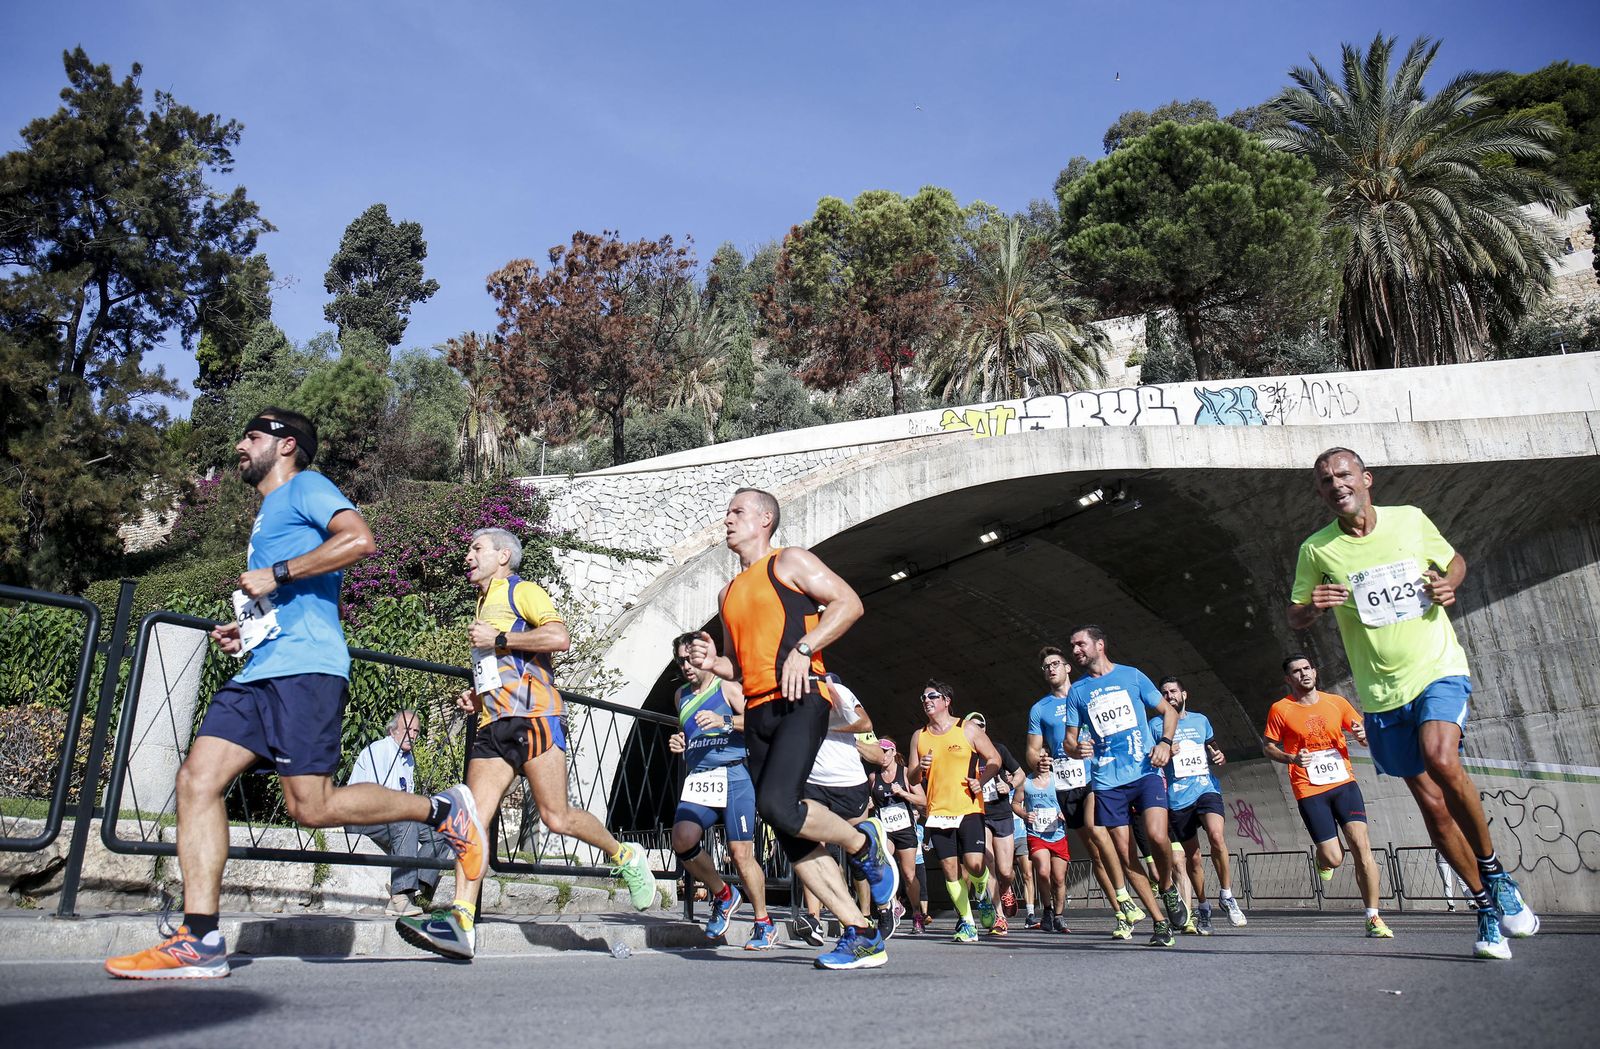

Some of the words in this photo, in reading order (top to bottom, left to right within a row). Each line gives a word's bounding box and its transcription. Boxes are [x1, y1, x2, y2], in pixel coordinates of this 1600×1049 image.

[1298, 377, 1361, 419] ACAB
[1367, 582, 1416, 607] 6123
[1095, 704, 1131, 725] 18073
[1180, 756, 1202, 767] 1245
[1314, 761, 1339, 775] 1961
[1056, 767, 1083, 780] 15913
[689, 781, 724, 793] 13513
[884, 811, 907, 824] 15691
